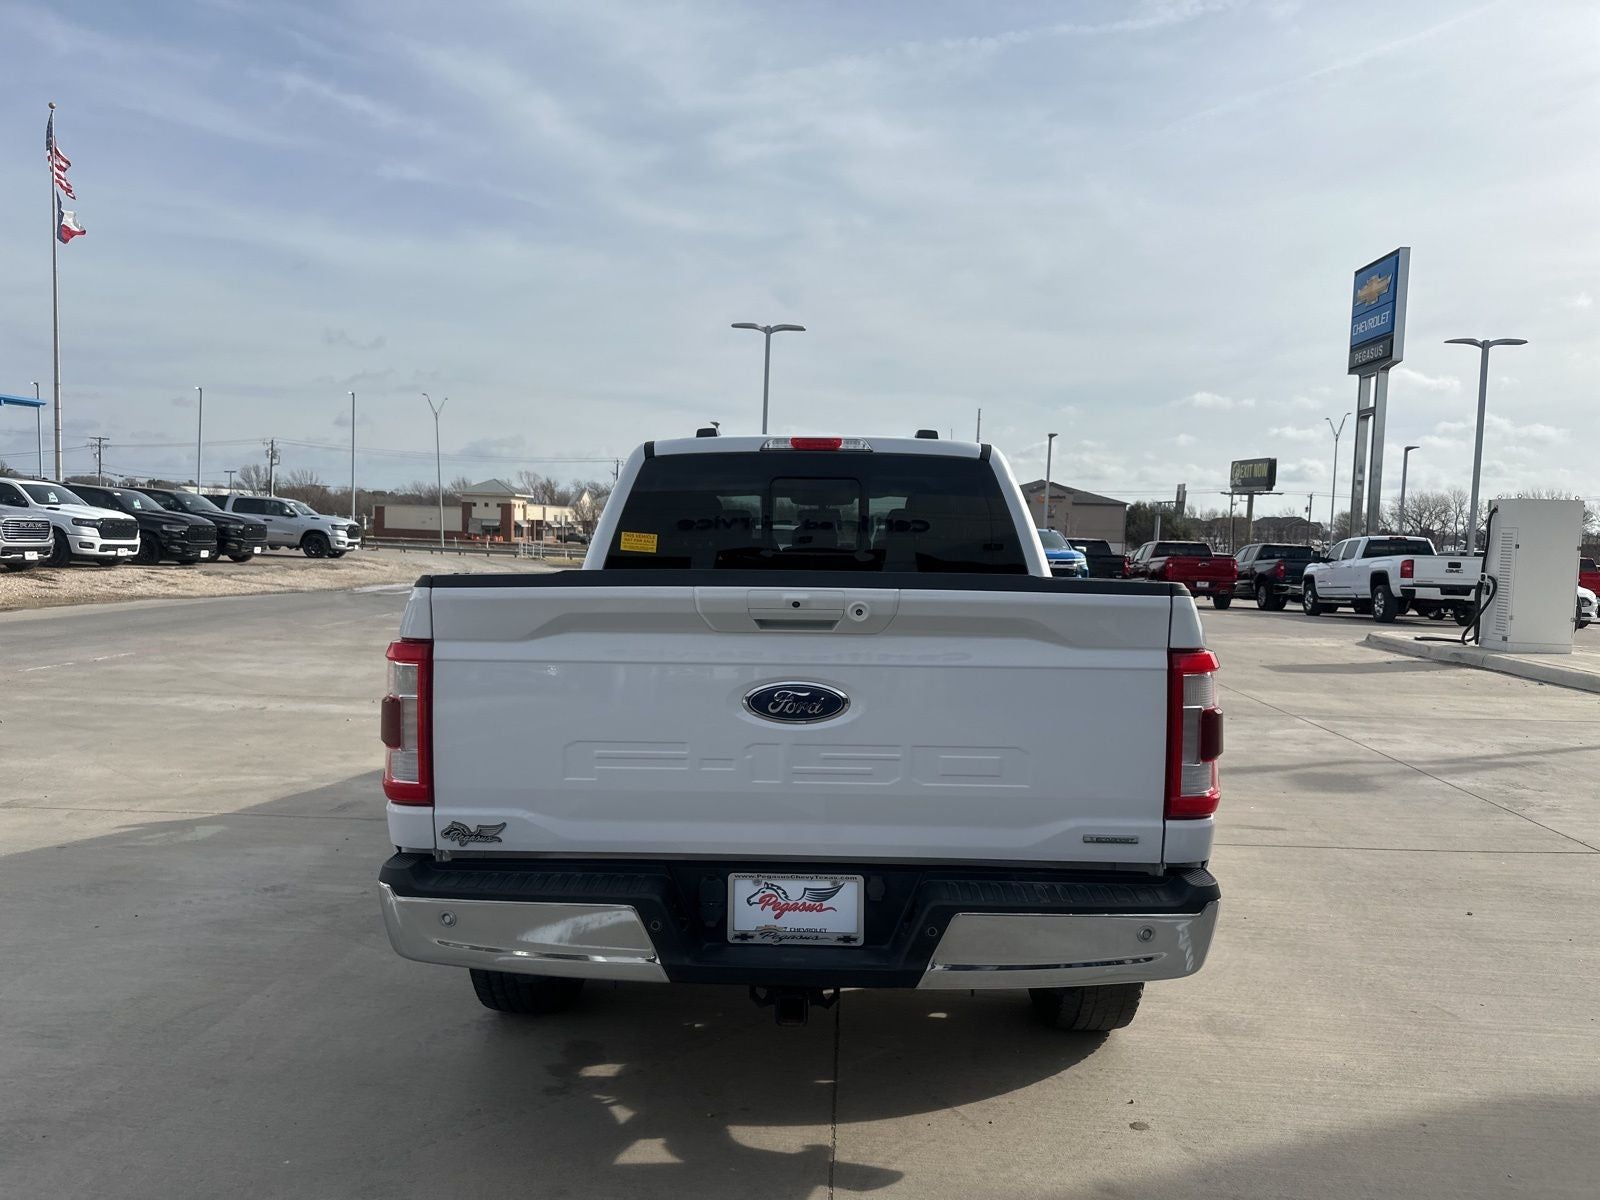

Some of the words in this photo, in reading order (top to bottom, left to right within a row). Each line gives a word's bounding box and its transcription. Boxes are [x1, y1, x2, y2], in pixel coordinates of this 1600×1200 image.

[1352, 311, 1390, 336] CHEVROLET
[1354, 345, 1384, 363] PEGASUS
[767, 690, 825, 714] Ford
[563, 740, 1030, 788] F-150
[759, 893, 837, 920] Pegasus
